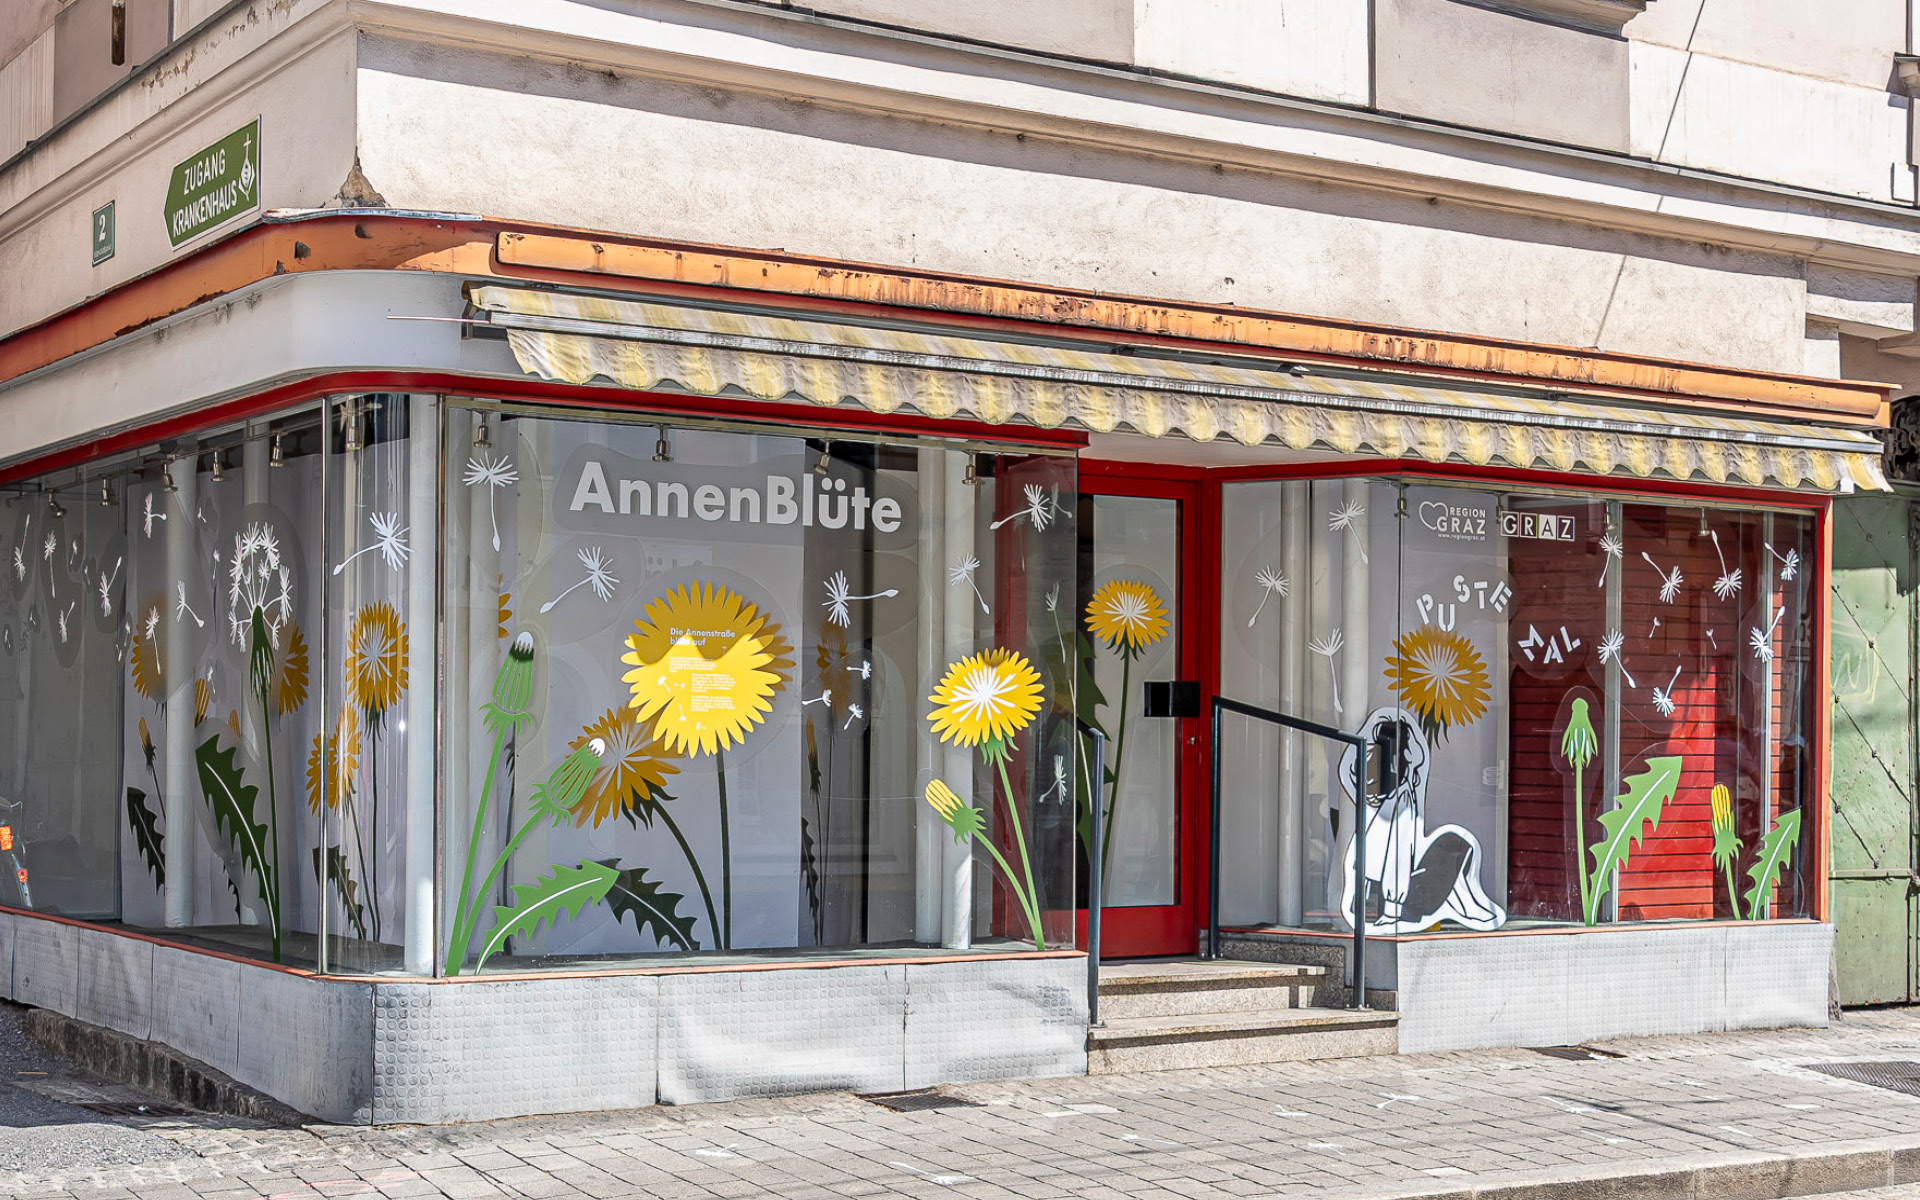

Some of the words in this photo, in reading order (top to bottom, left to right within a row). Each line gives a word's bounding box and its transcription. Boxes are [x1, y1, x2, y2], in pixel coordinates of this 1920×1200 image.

[183, 148, 226, 195] ZUGANG
[172, 180, 237, 238] KRANKENHAUS
[98, 214, 107, 242] 2
[569, 461, 902, 533] AnnenBlüte
[1450, 506, 1486, 518] REGION
[1436, 516, 1486, 535] GRAZ
[1502, 514, 1572, 540] GRAZ
[1415, 574, 1513, 633] PUSTE
[670, 627, 683, 636] Die
[685, 628, 736, 638] Annenstraße
[1517, 623, 1582, 664] MAL
